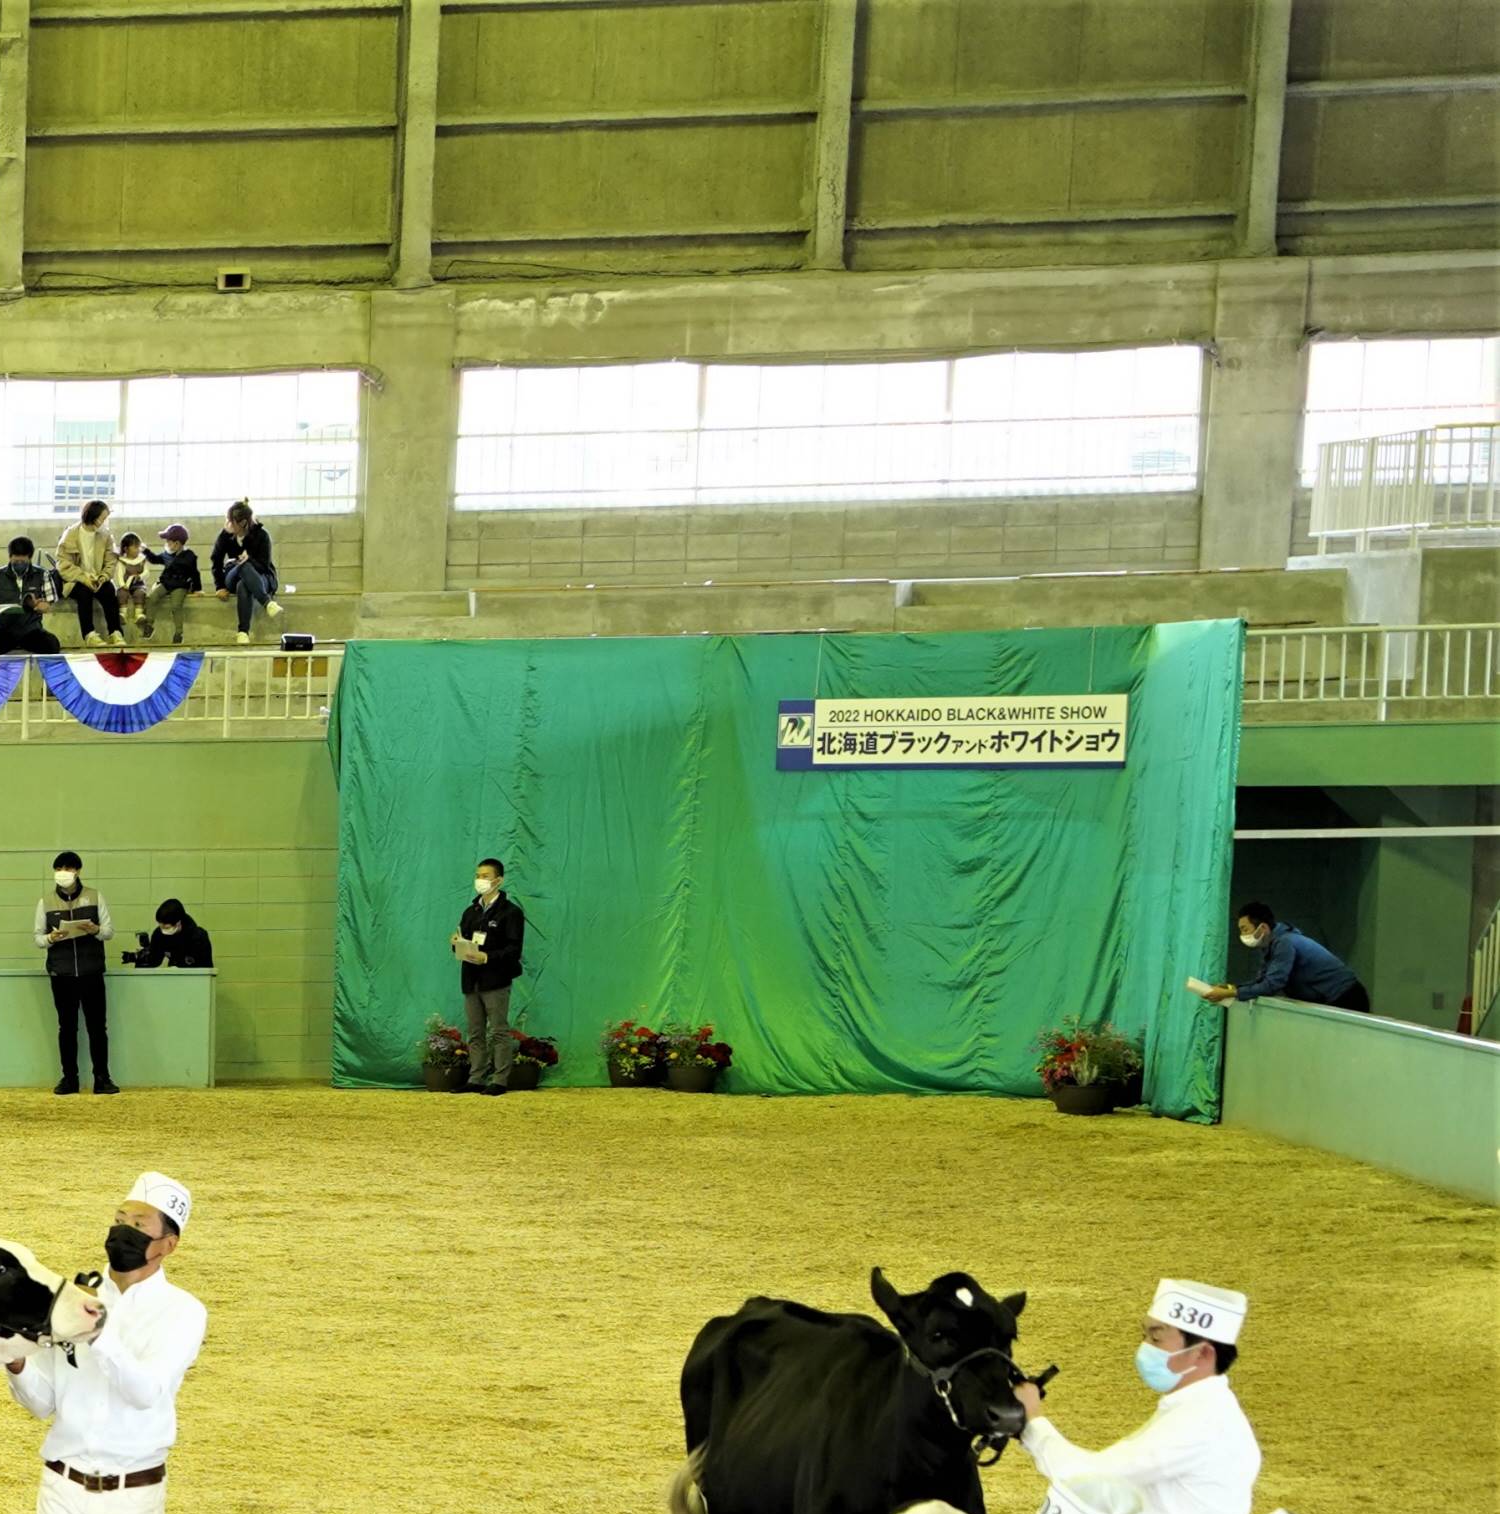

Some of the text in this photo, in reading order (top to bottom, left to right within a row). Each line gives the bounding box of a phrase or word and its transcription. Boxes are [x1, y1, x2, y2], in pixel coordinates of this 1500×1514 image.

[829, 705, 1108, 723] 2022 HOKKAIDO BLACK&WHITE SHOW
[816, 729, 1121, 756] 北海道ブラックアンドホワイトショウ
[1168, 1301, 1214, 1330] 330
